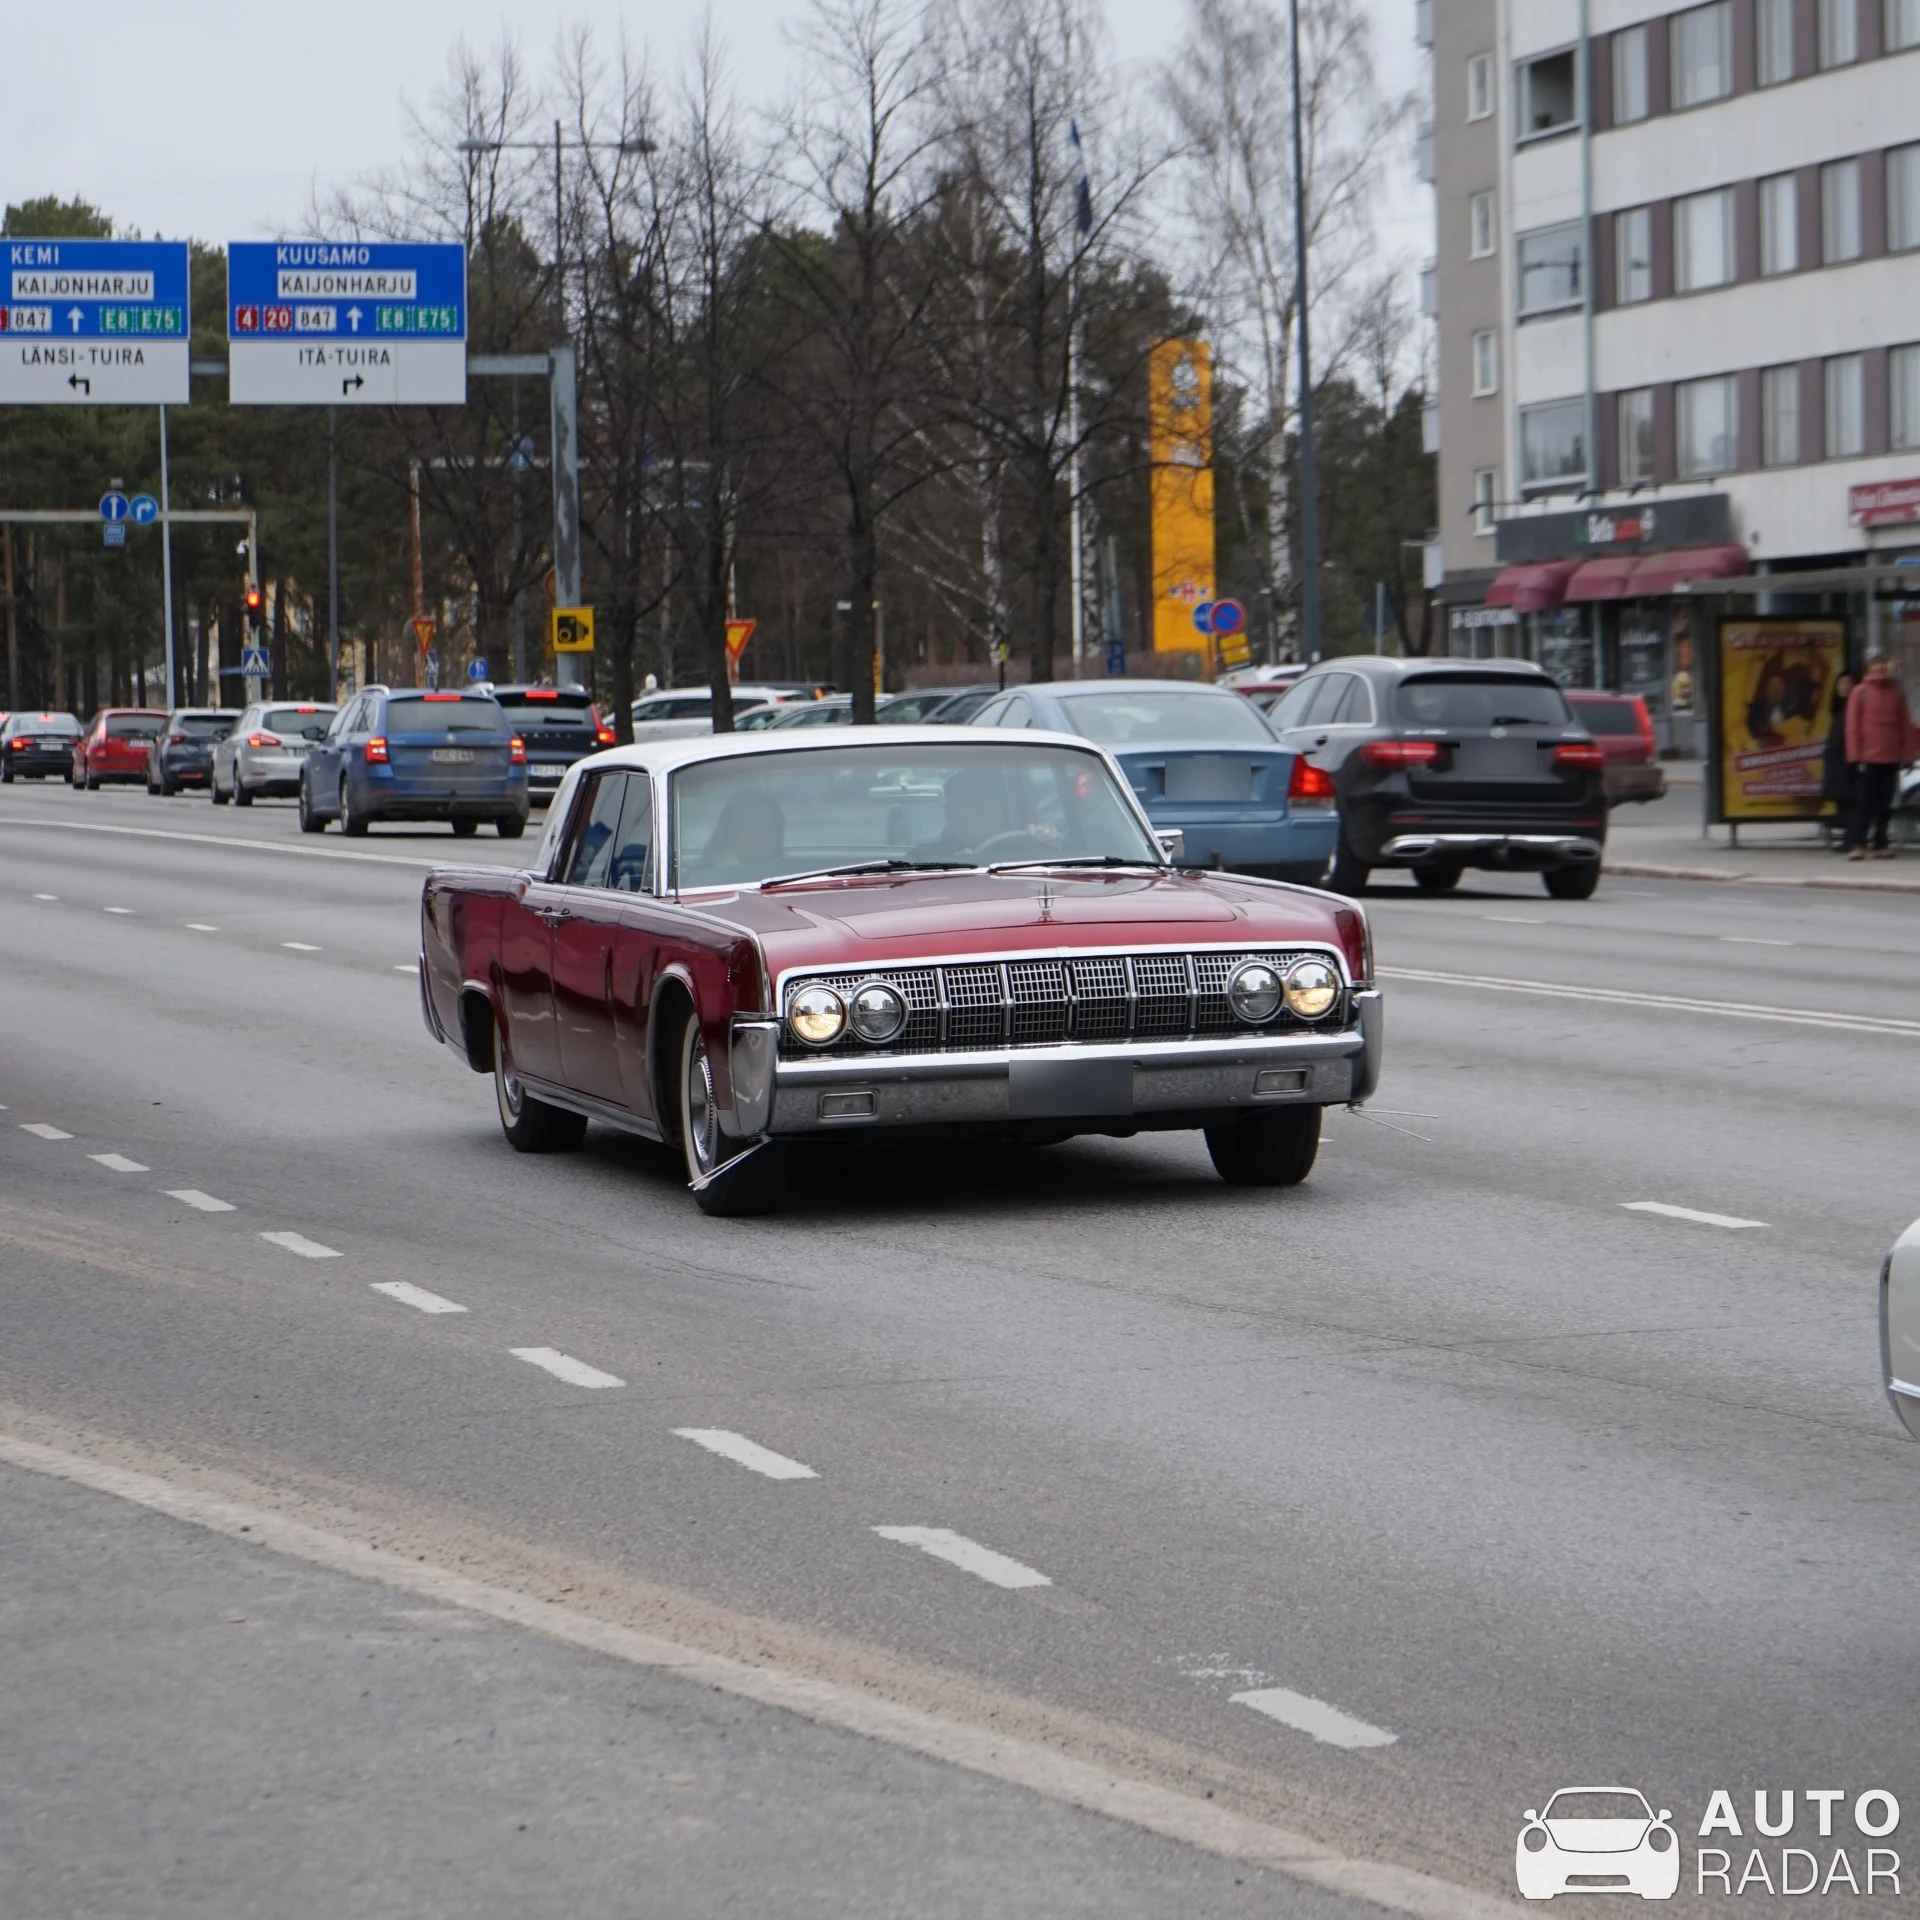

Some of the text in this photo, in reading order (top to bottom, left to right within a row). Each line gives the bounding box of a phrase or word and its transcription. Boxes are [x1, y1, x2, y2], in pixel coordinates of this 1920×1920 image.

[11, 245, 60, 265] KEMI
[276, 247, 370, 265] KUUSAMO
[17, 276, 149, 295] KAIJONHARJU
[281, 276, 412, 294] KAIJONHARJU
[15, 312, 47, 328] 847
[105, 312, 128, 329] E8
[142, 312, 174, 329] E75
[241, 310, 449, 328] 4 20 847 E8 E75
[22, 346, 145, 365] LÄNSI-TUIRA
[300, 347, 391, 366] ITÄ-TUIRA
